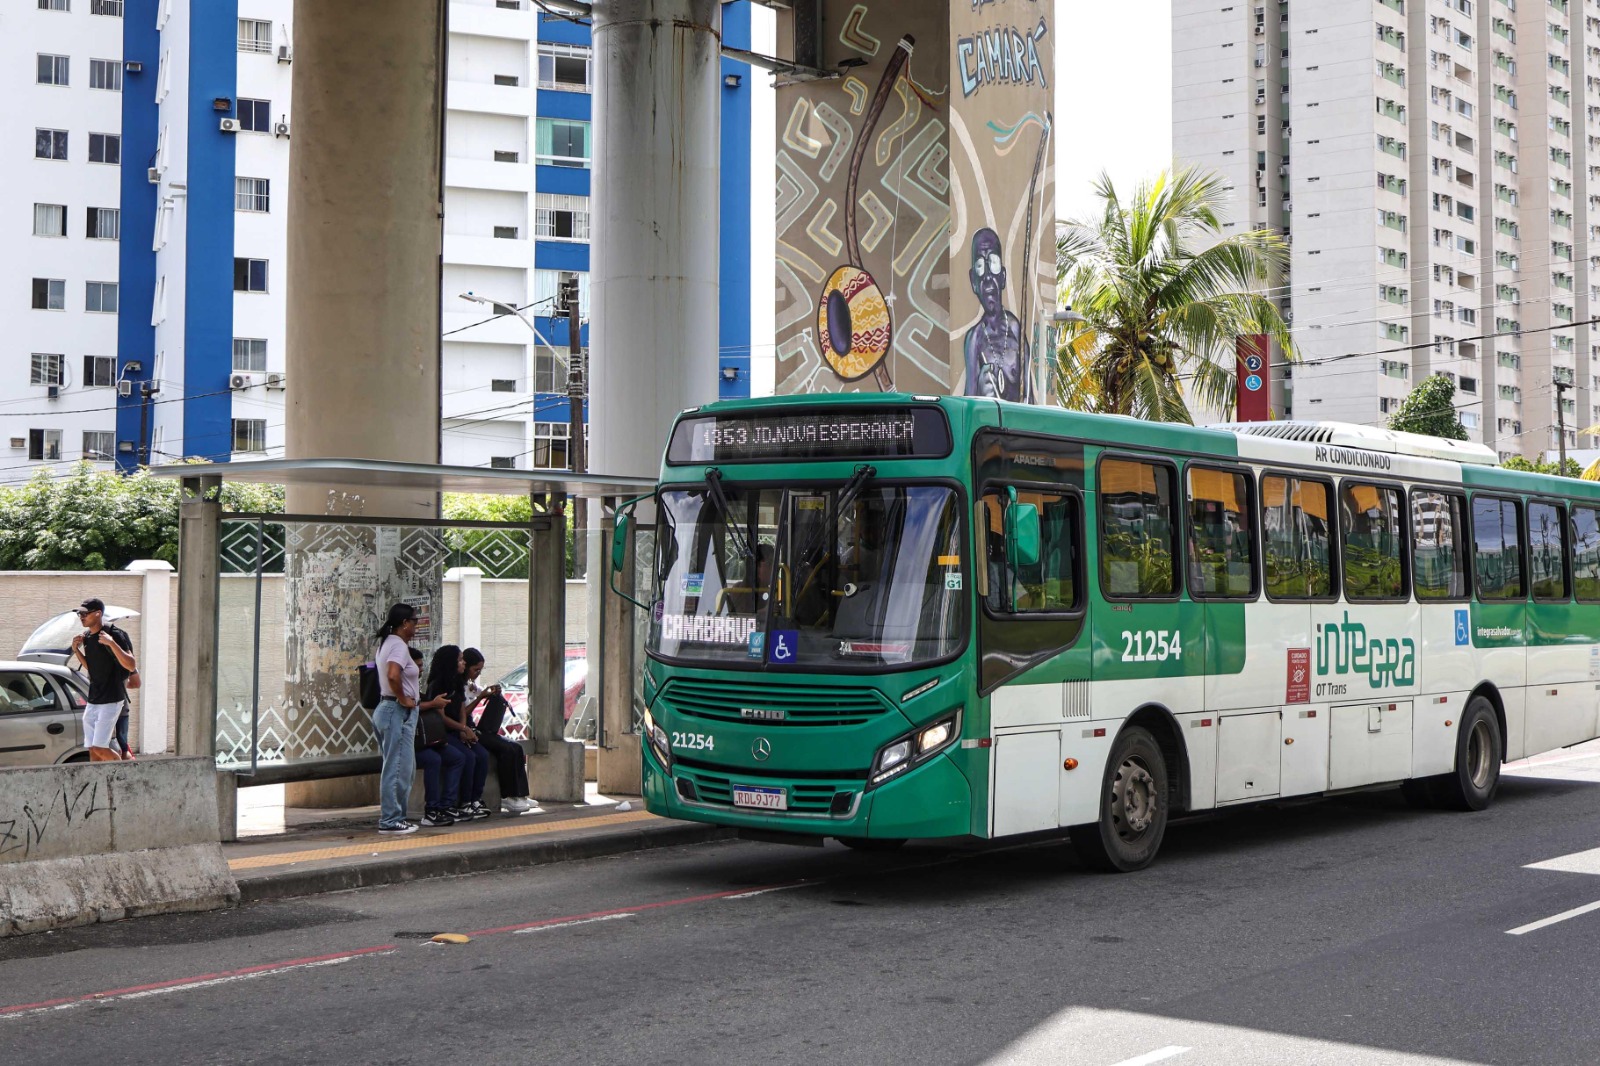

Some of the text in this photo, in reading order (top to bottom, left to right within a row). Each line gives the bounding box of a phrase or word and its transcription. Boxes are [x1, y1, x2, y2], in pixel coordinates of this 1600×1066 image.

[957, 20, 1047, 98] CAMARÁ
[1250, 358, 1257, 368] 2
[1013, 454, 1045, 466] APACHE
[1315, 446, 1391, 470] AR CONDICIONADO
[946, 579, 961, 589] G1
[662, 614, 756, 644] CANABRAVA
[1121, 630, 1182, 662] 21254
[1316, 683, 1326, 696] OT
[1328, 682, 1347, 696] Trans
[672, 731, 715, 751] 21254
[737, 791, 781, 807] RDL9J77
